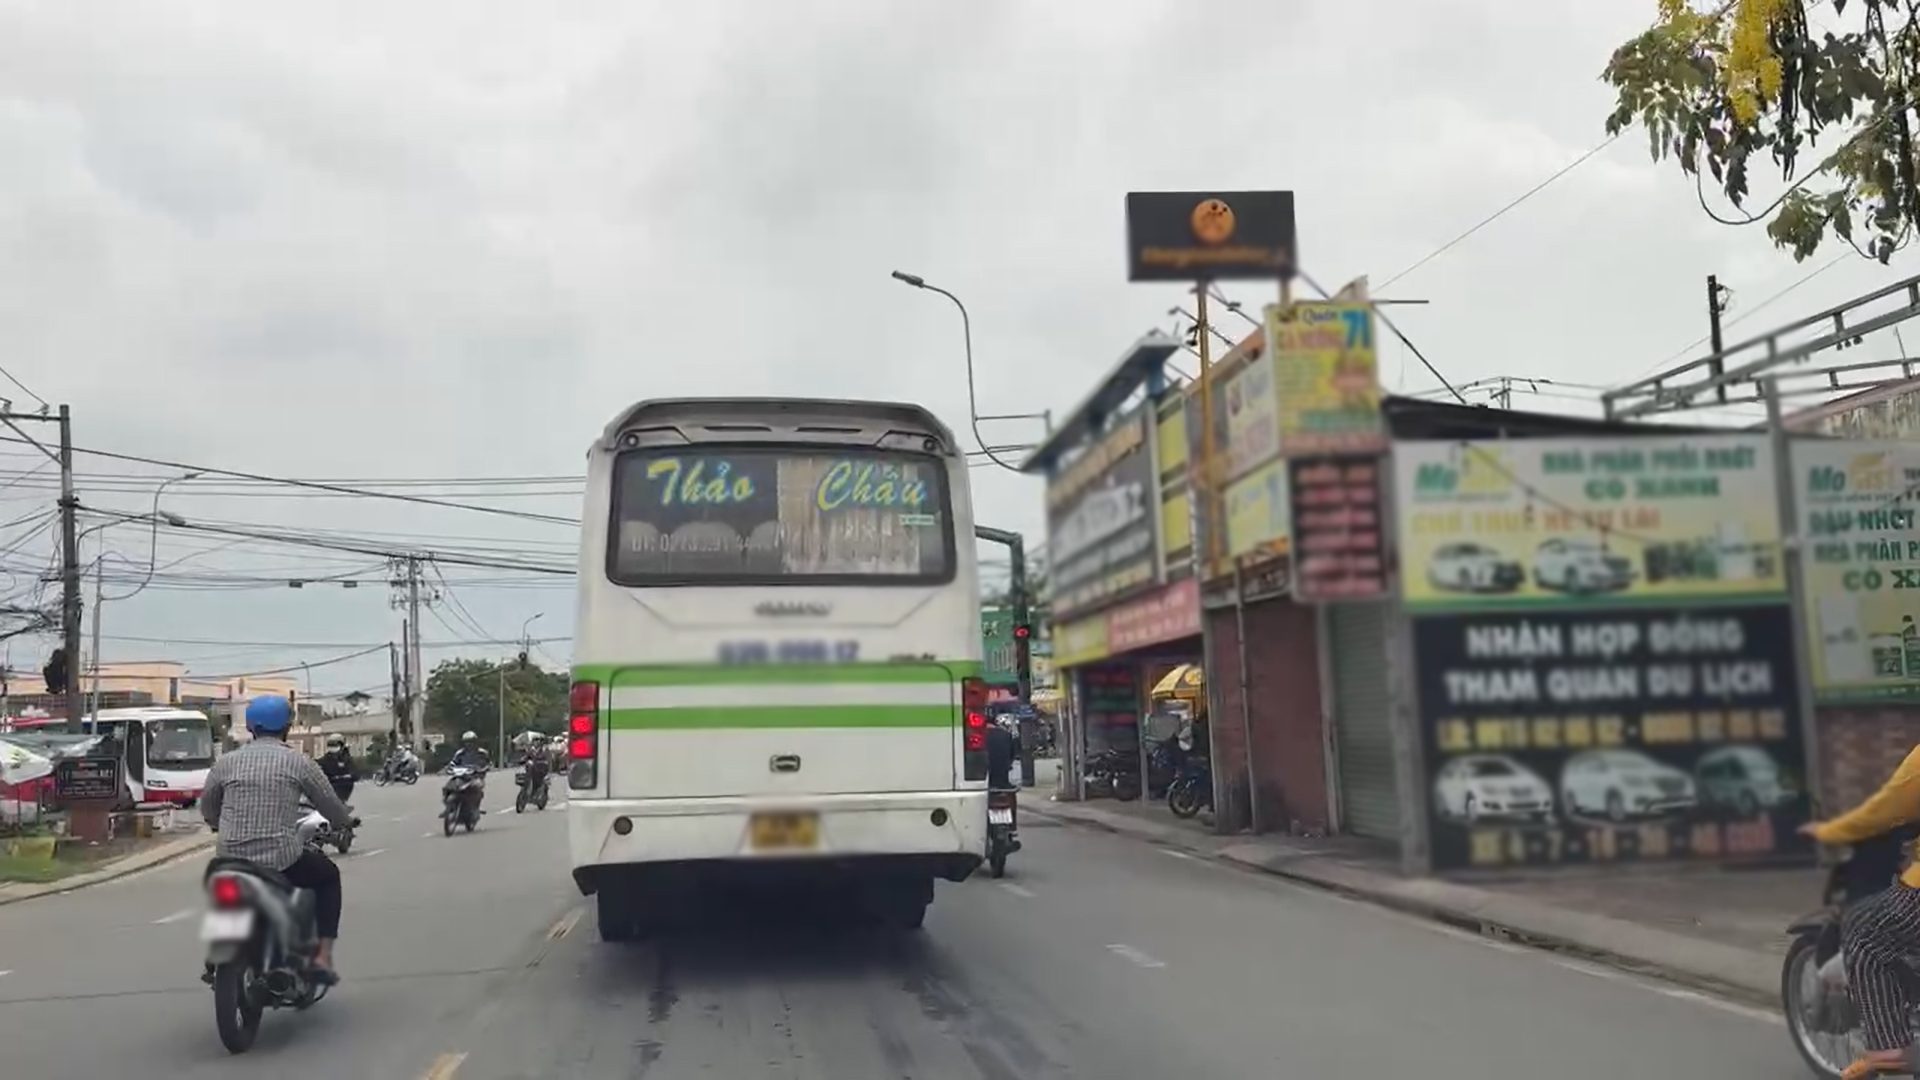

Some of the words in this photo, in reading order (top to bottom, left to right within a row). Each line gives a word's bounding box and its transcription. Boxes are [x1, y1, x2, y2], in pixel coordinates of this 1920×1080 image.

[1343, 309, 1371, 349] 71
[647, 460, 755, 505] Thảo
[816, 461, 925, 510] Châu
[1445, 669, 1540, 702] THAM
[1547, 666, 1637, 699] QUAN
[1648, 664, 1692, 697] DU
[1702, 660, 1773, 702] LỊCH
